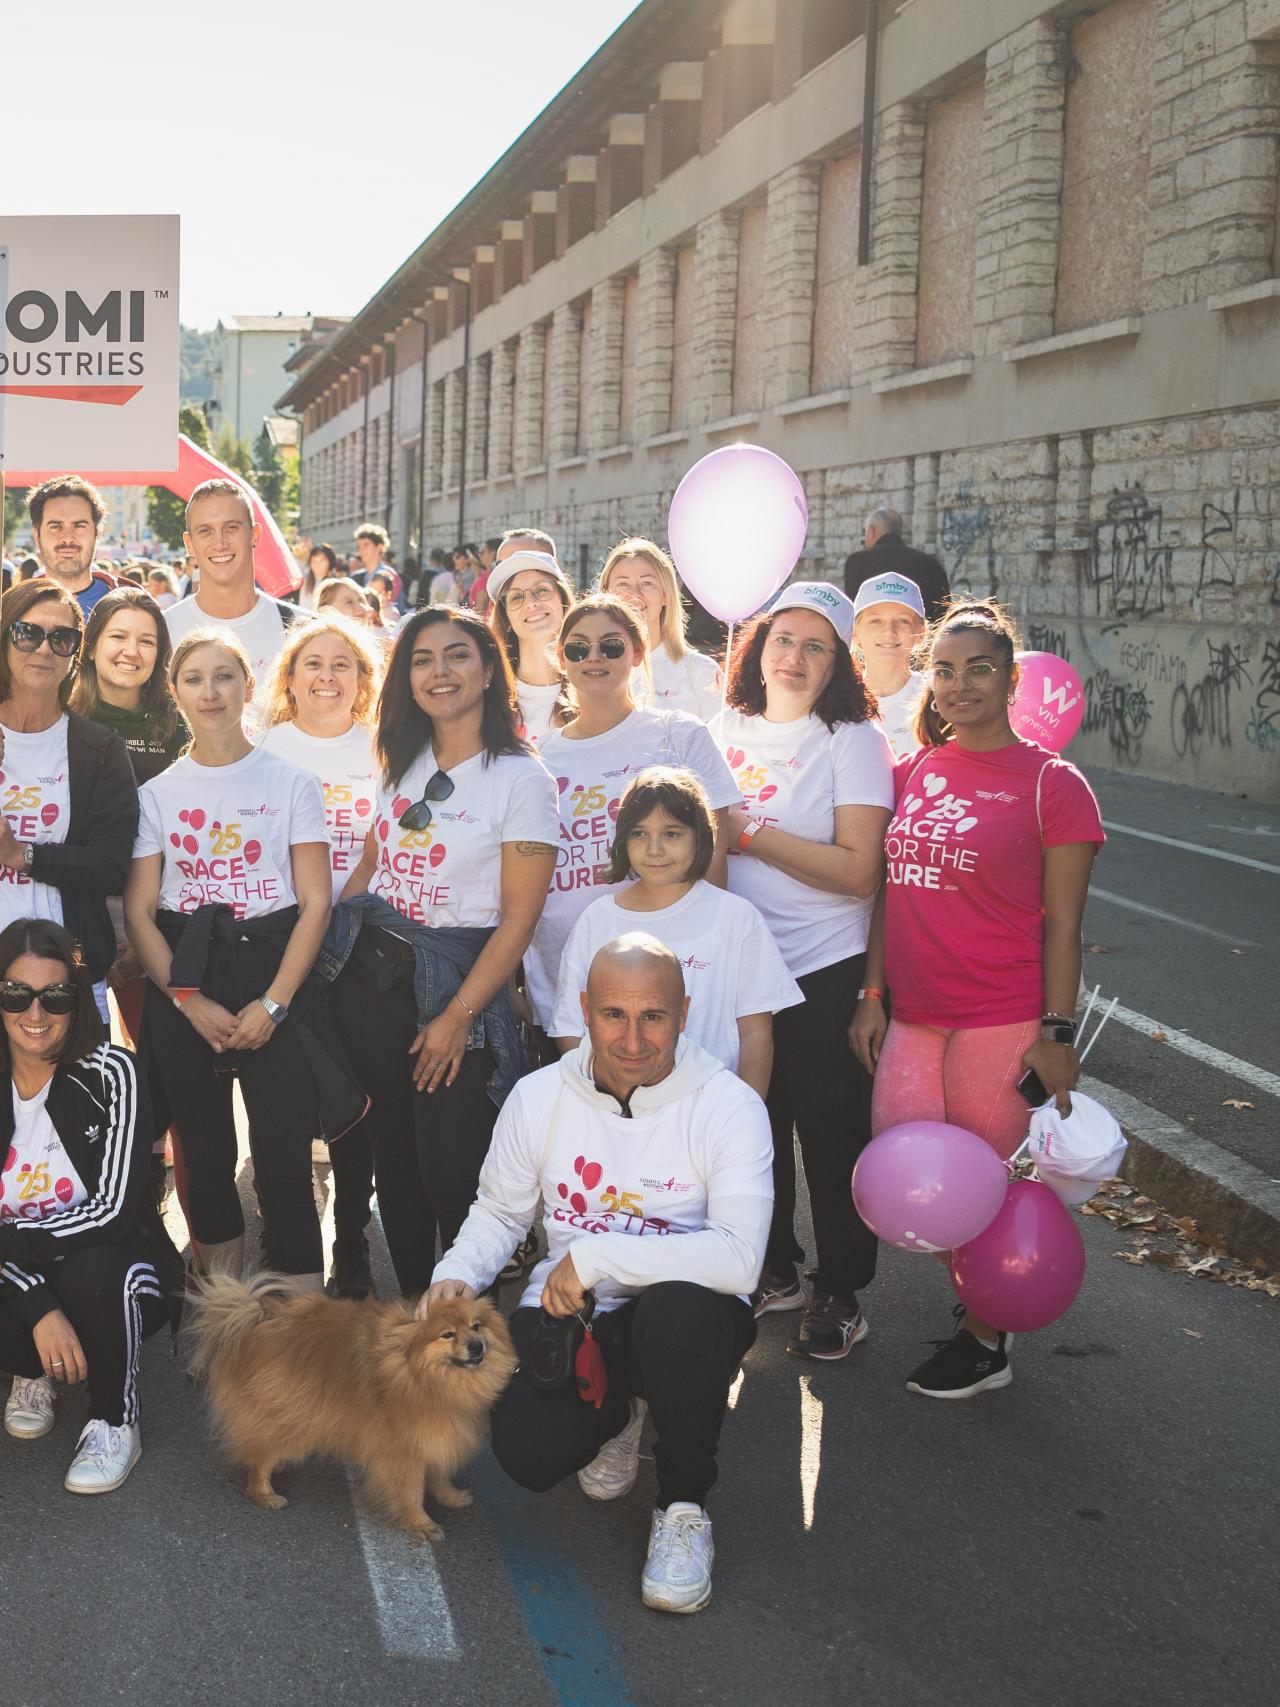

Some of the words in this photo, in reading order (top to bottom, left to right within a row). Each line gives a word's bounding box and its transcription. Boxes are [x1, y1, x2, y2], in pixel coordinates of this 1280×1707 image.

[804, 587, 841, 607] bimby
[876, 582, 909, 592] bimby
[1021, 713, 1055, 742] energia
[1037, 706, 1061, 728] VIVI
[738, 767, 768, 792] 25
[3, 786, 41, 811] 25
[570, 784, 607, 816] 25
[926, 795, 973, 820] 25
[209, 823, 242, 856] 25
[558, 815, 608, 842] ACE
[175, 856, 247, 881] RACE
[381, 847, 426, 877] ACE
[926, 842, 979, 873] THE
[886, 862, 941, 890] URE
[228, 878, 280, 901] THE
[16, 1162, 52, 1200] 25
[0, 1198, 57, 1220] ACE
